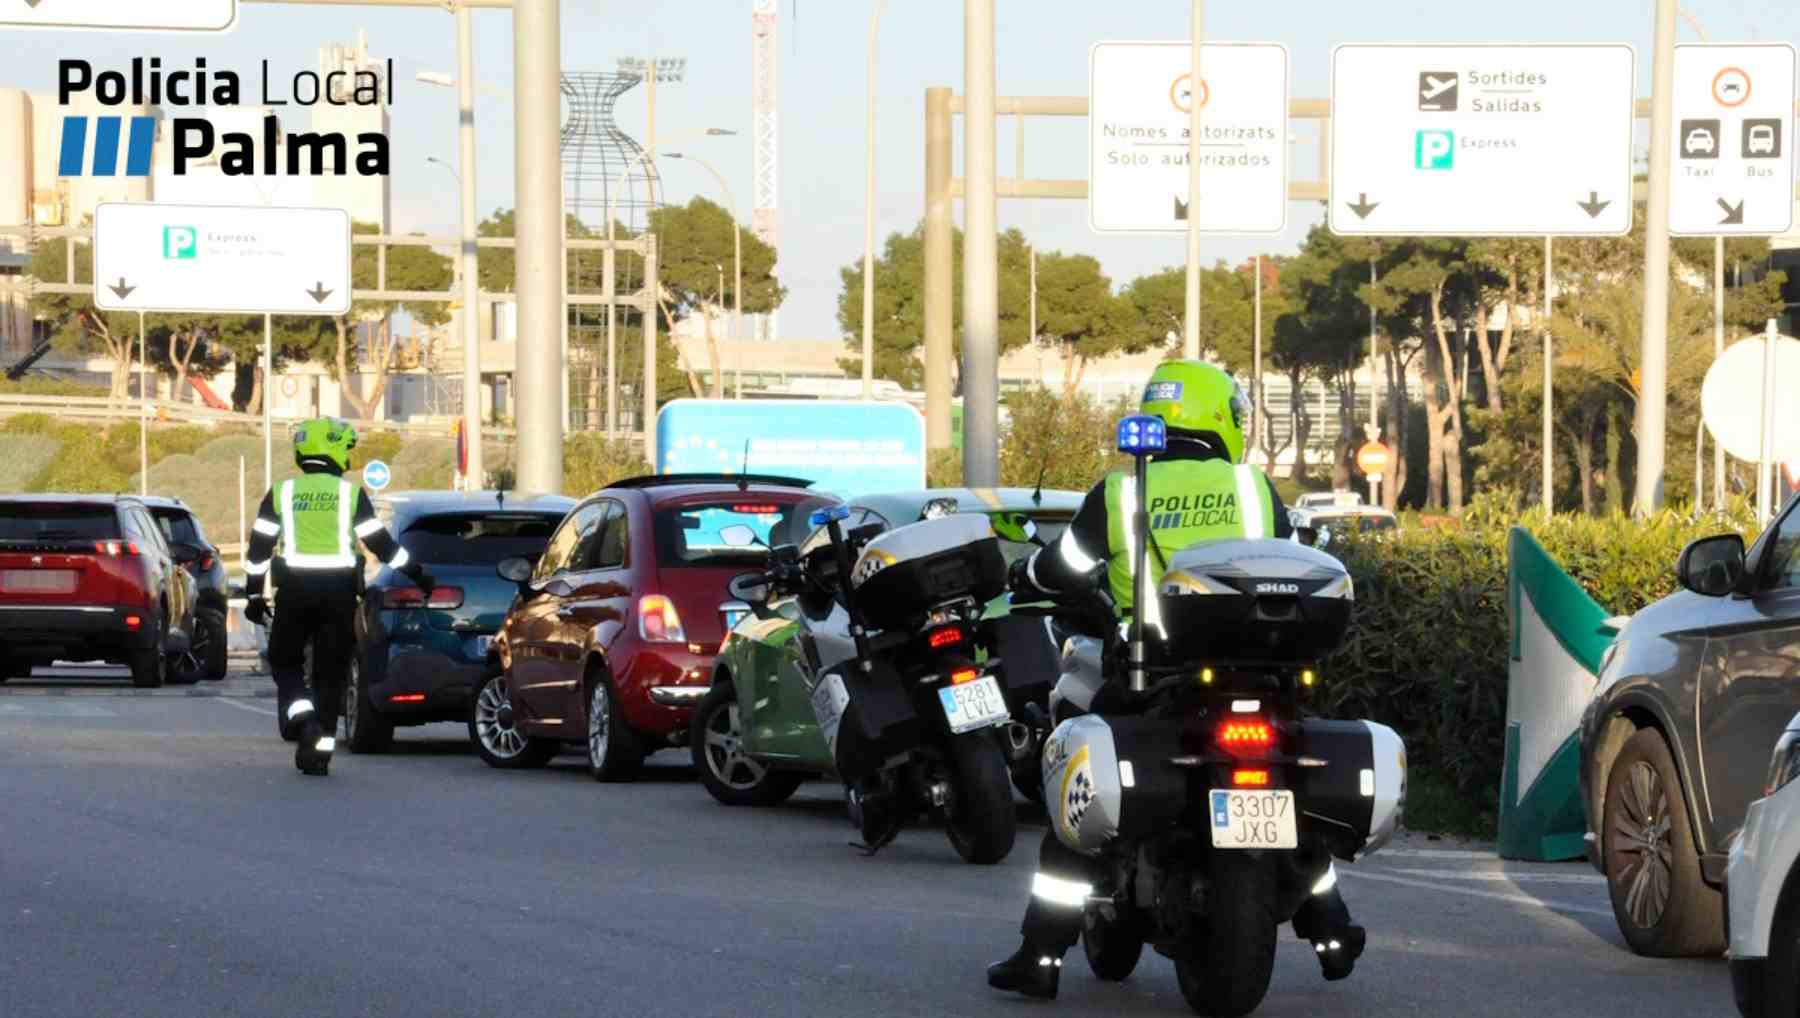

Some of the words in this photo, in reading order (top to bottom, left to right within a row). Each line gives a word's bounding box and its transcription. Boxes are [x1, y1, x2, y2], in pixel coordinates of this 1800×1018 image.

[1468, 71, 1547, 85] Sortides
[1472, 98, 1542, 112] Salidas
[1103, 123, 1168, 138] Nomes
[1180, 125, 1276, 139] atorizats
[1460, 135, 1517, 149] Express
[1107, 151, 1150, 165] Solo
[1161, 152, 1272, 167] autrizados
[1684, 166, 1715, 177] Taxi
[1746, 165, 1775, 177] Bus
[1151, 492, 1236, 512] POLICIA
[1181, 509, 1240, 528] LOCAL
[1255, 582, 1299, 593] SHAD
[962, 699, 994, 720] LVL
[1231, 795, 1289, 818] 3307
[1234, 820, 1278, 843] JXG
